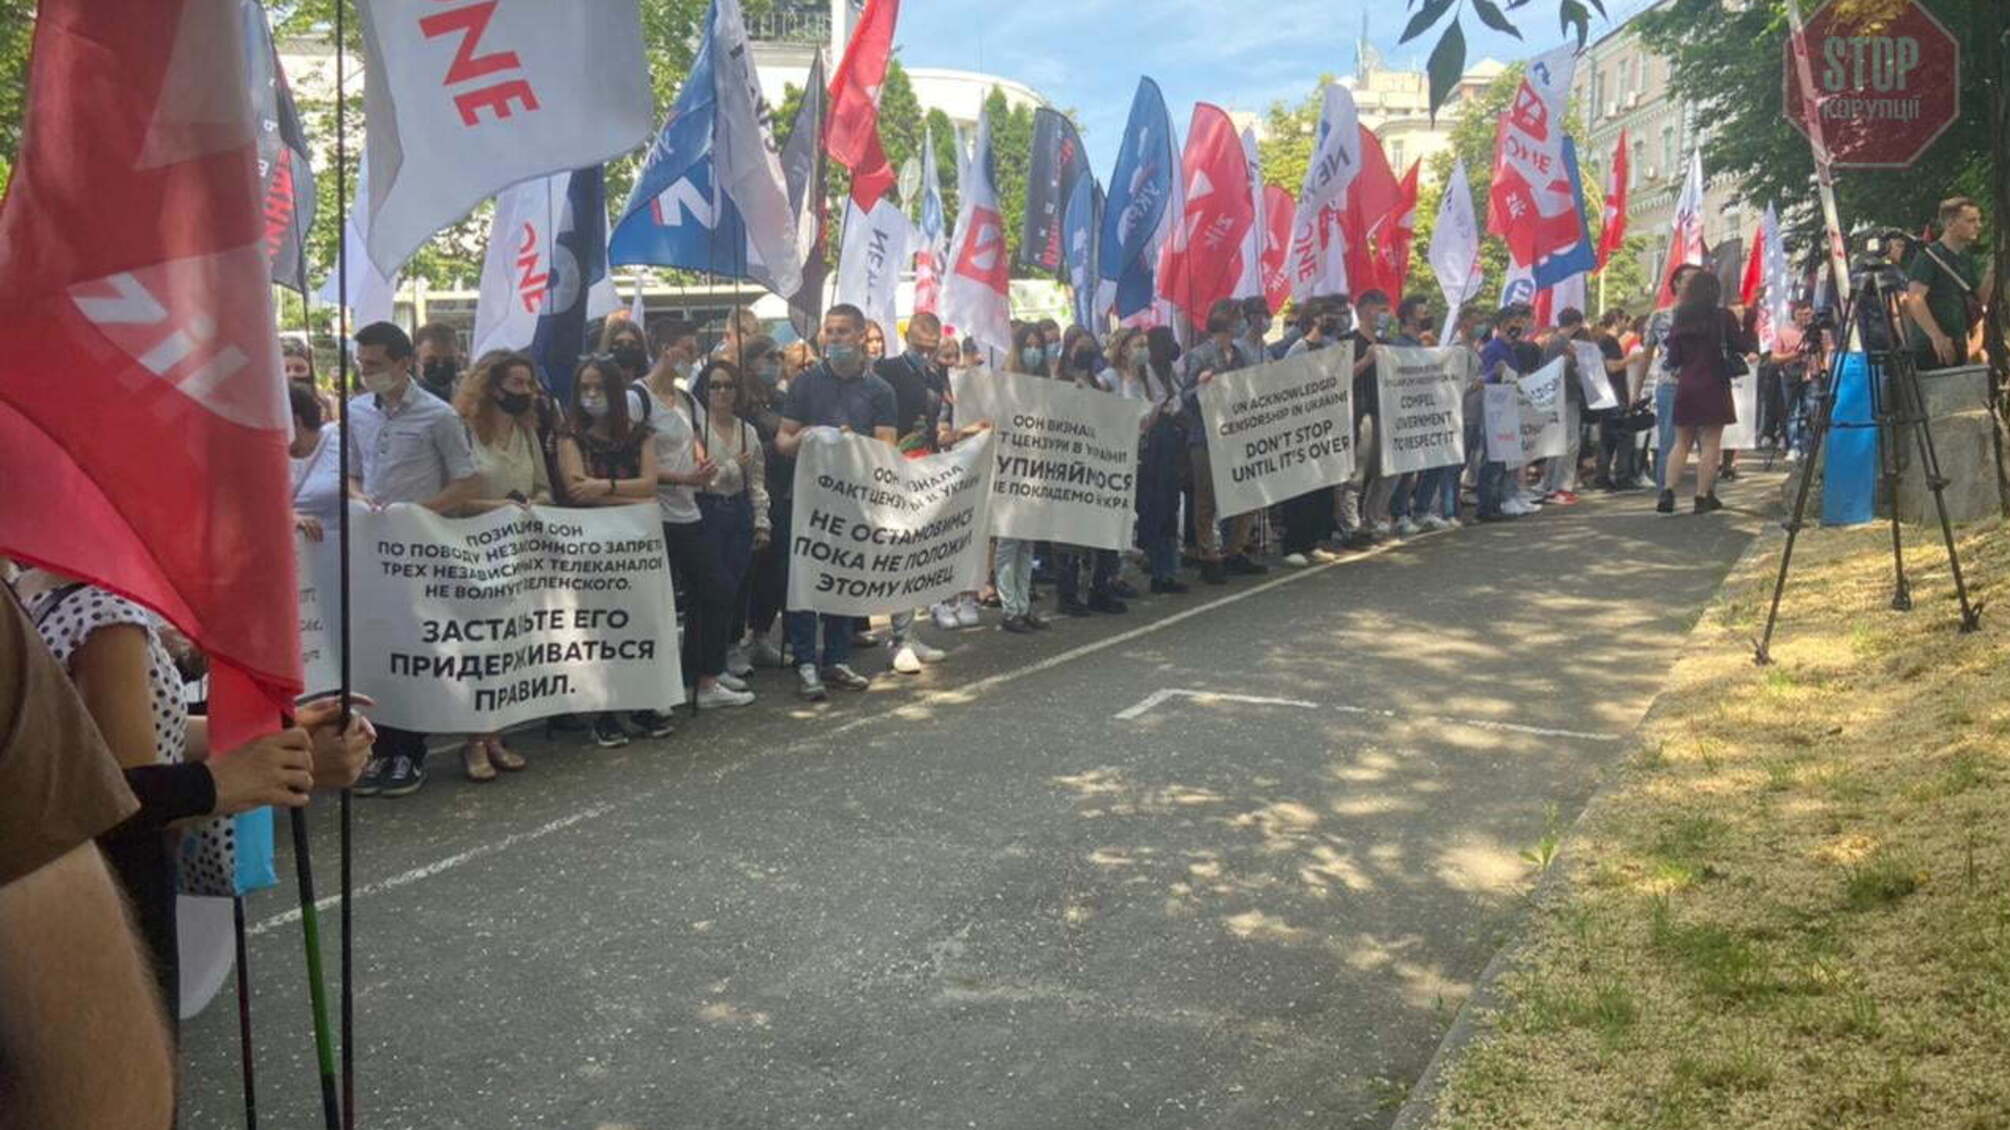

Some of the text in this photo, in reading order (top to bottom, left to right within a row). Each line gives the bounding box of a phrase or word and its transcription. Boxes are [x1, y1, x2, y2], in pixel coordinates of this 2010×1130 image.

[418, 0, 541, 127] NE
[1245, 419, 1333, 459] DON'T STOP
[1231, 456, 1277, 482] UNTIL
[1279, 448, 1306, 471] IT'S
[818, 474, 868, 501] ФАКТ
[809, 509, 847, 537] НЕ
[378, 541, 405, 556] ПО
[793, 537, 866, 571] ПОКА
[871, 555, 903, 573] НЕ
[382, 561, 428, 578] ТРЕХ
[815, 565, 954, 598] ЭТОМУ КОНЕЦ
[425, 584, 449, 598] НЕ
[574, 609, 630, 629] ЕГО
[474, 675, 577, 711] ПРАВИЛ.
